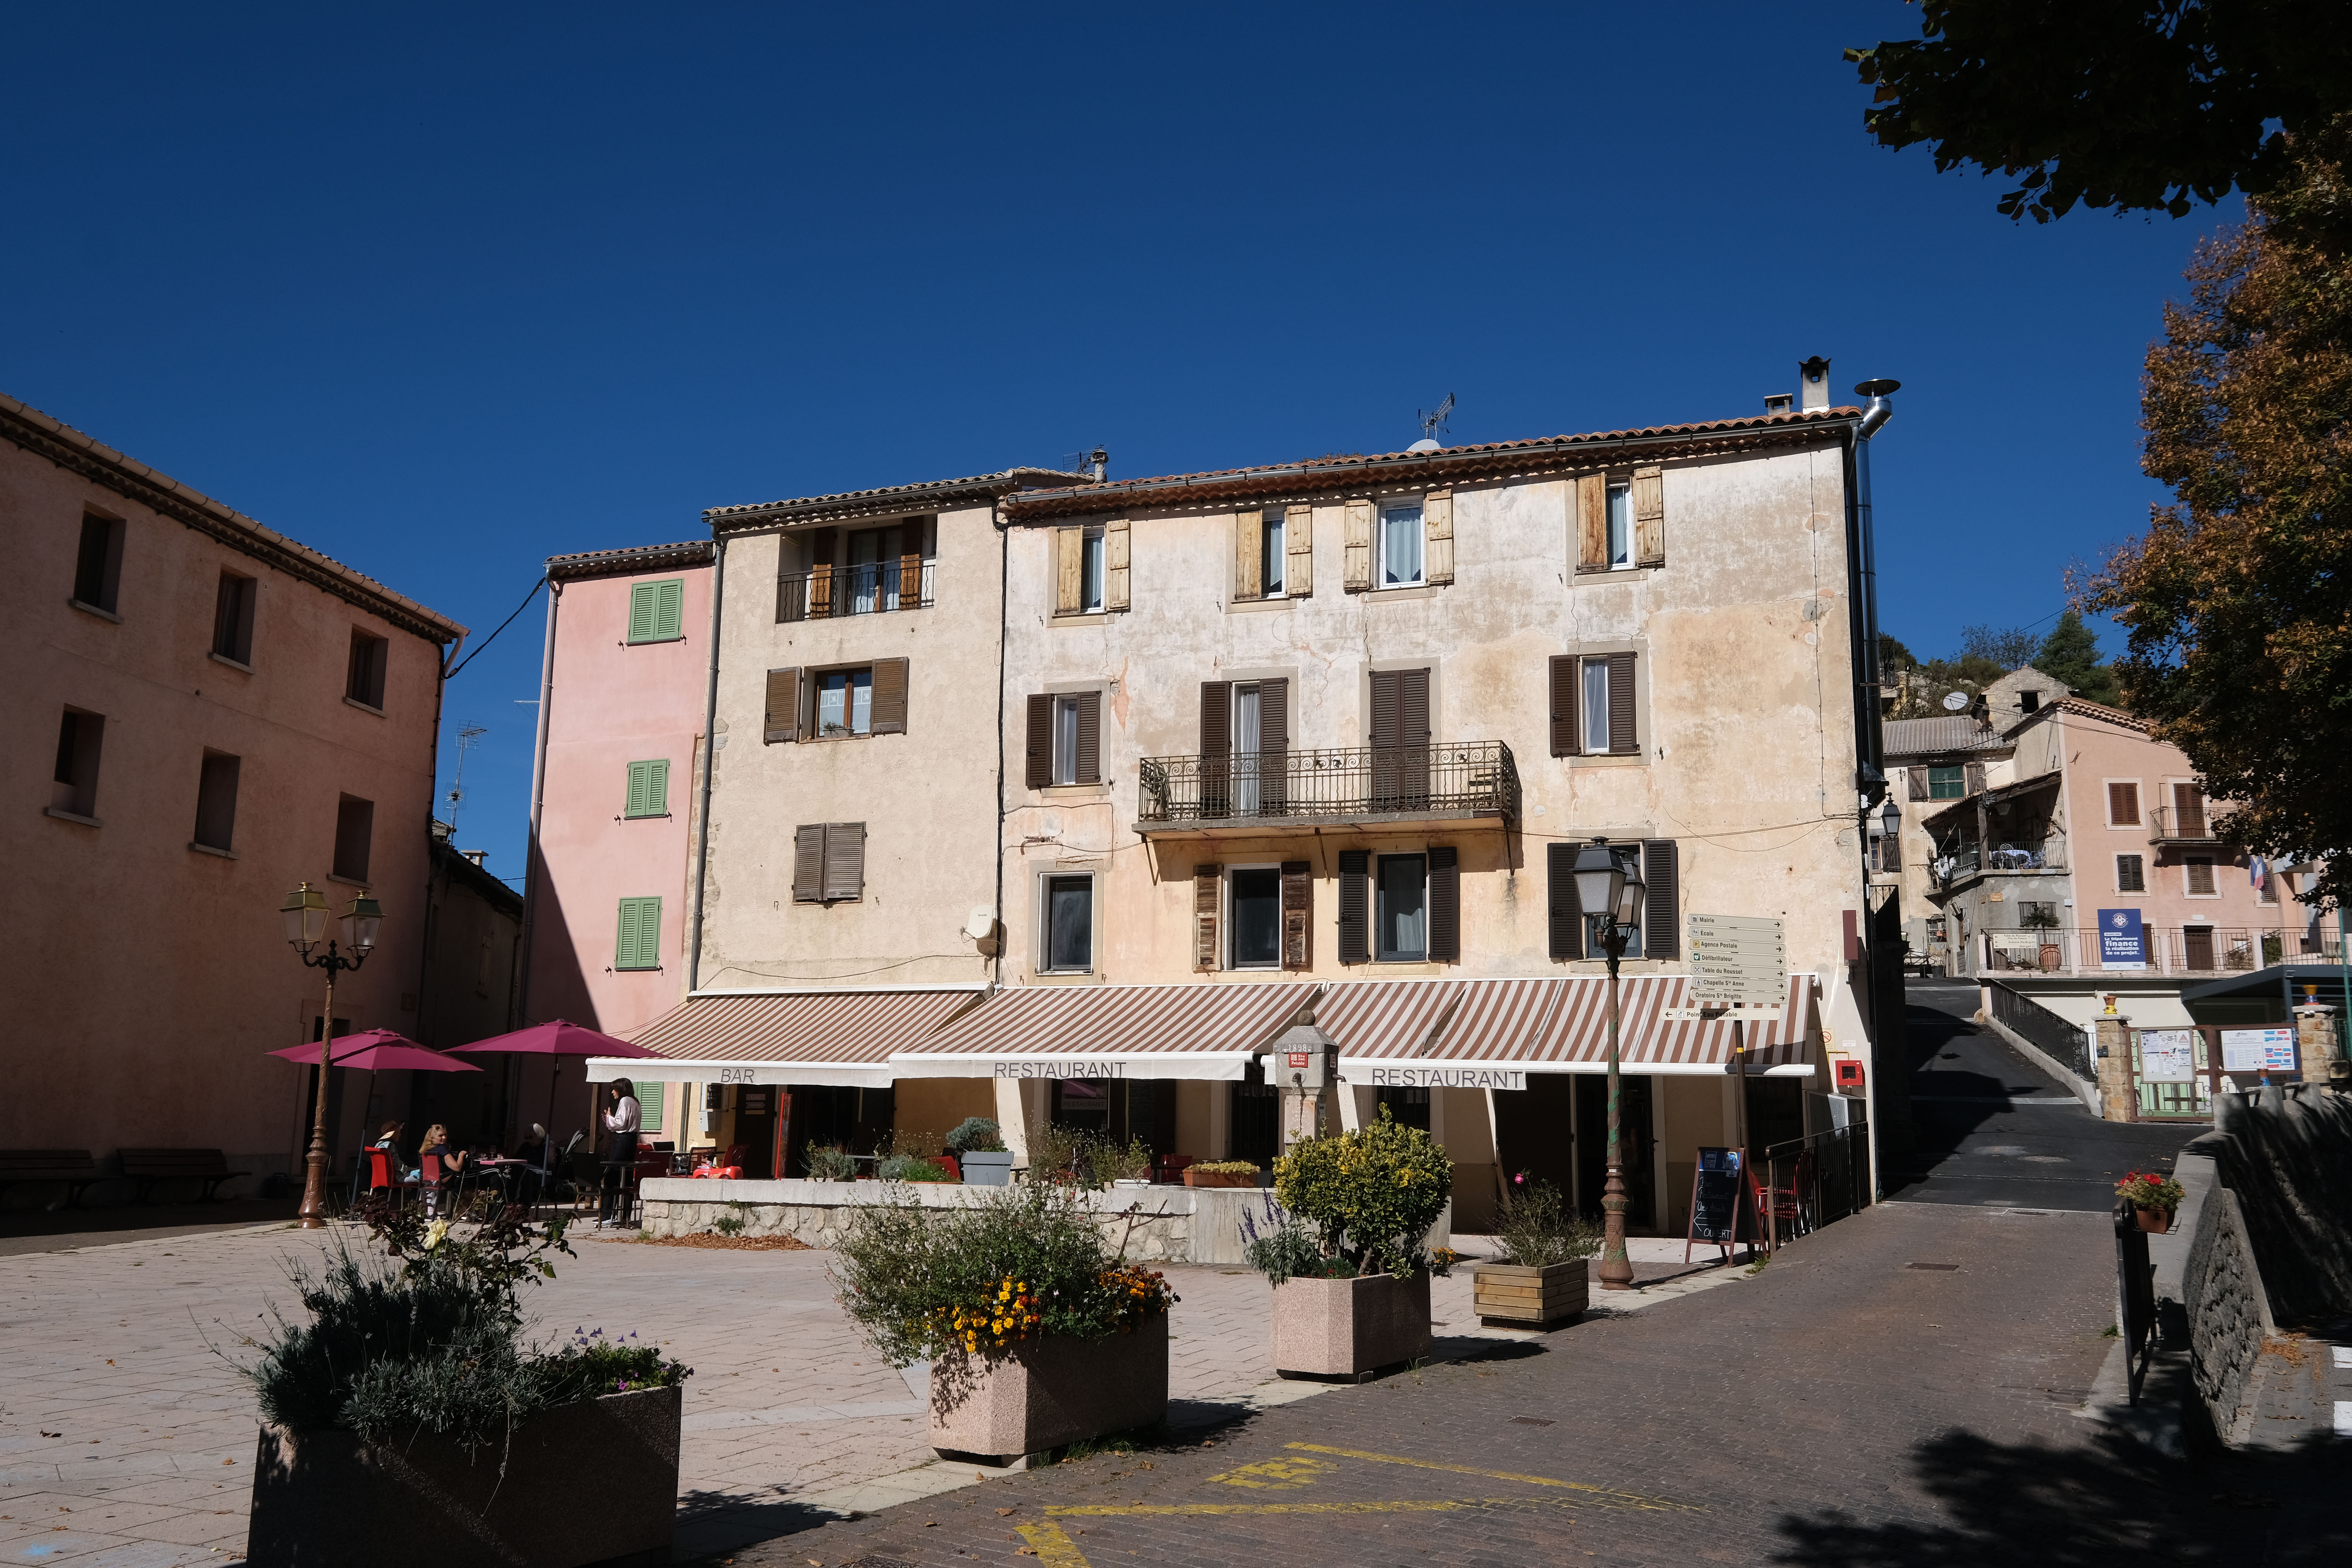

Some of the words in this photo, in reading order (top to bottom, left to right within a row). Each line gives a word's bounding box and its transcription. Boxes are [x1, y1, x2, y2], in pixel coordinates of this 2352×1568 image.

[720, 1069, 754, 1083] BAR
[994, 1061, 1127, 1079] RESTAURANT
[1372, 1068, 1523, 1089] RESTAURANT
[1700, 1176, 1713, 1187] Bar
[1703, 1228, 1732, 1239] OUVERT
